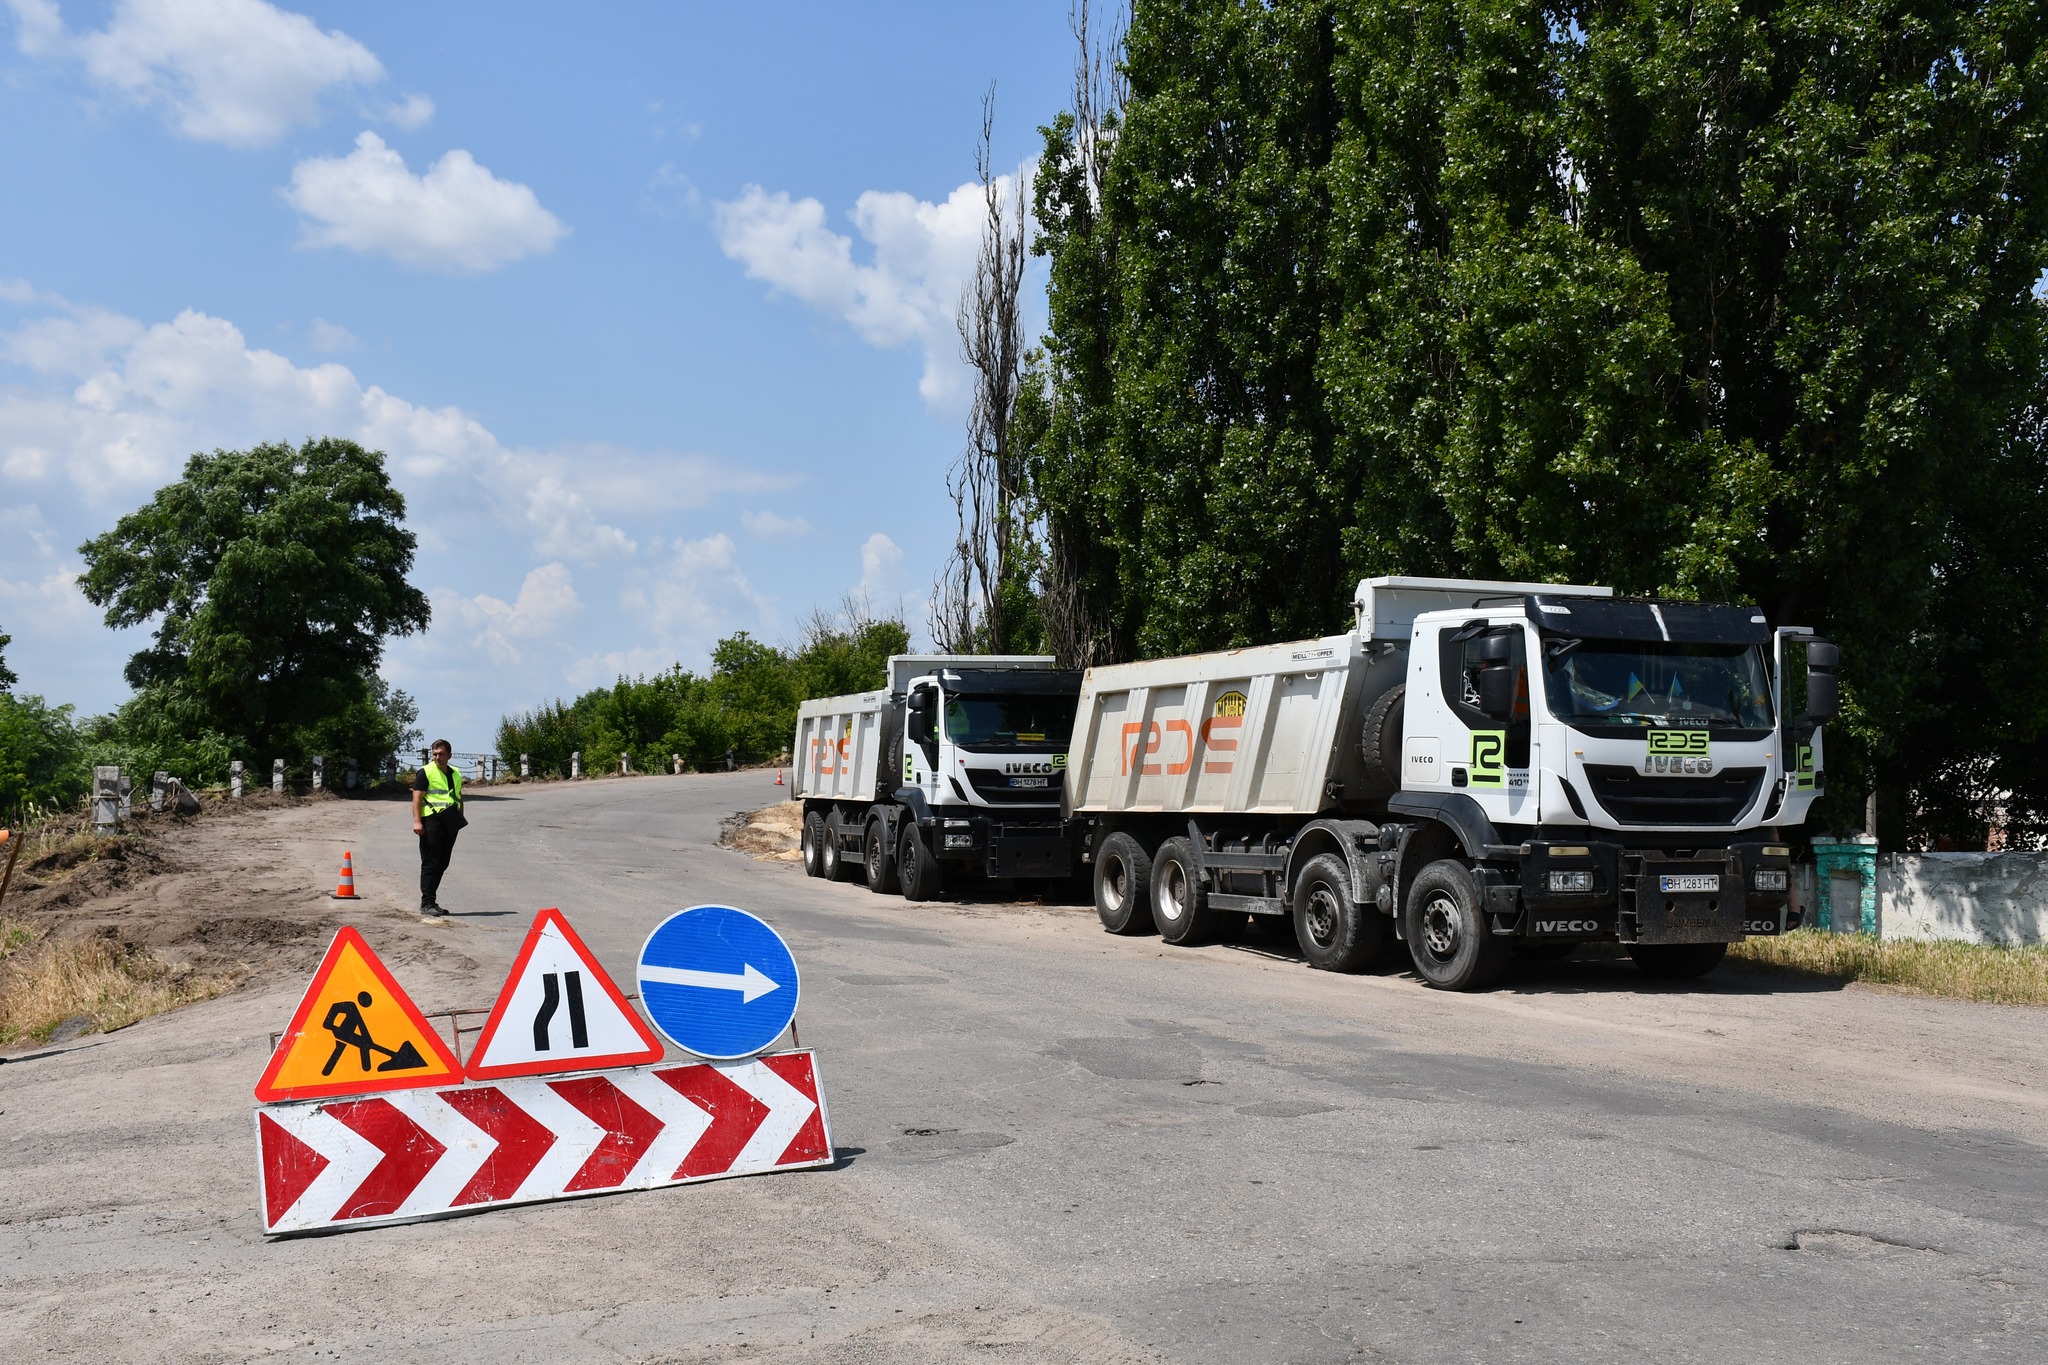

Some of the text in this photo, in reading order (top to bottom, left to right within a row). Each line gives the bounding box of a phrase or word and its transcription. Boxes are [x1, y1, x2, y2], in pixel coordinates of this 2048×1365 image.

[1679, 717, 1709, 726] IVECO
[1649, 732, 1707, 749] RDS
[1005, 763, 1052, 774] IVECO
[1644, 756, 1713, 774] IVECO
[1667, 878, 1716, 889] BH 1283 HT
[1535, 920, 1599, 932] IVECO
